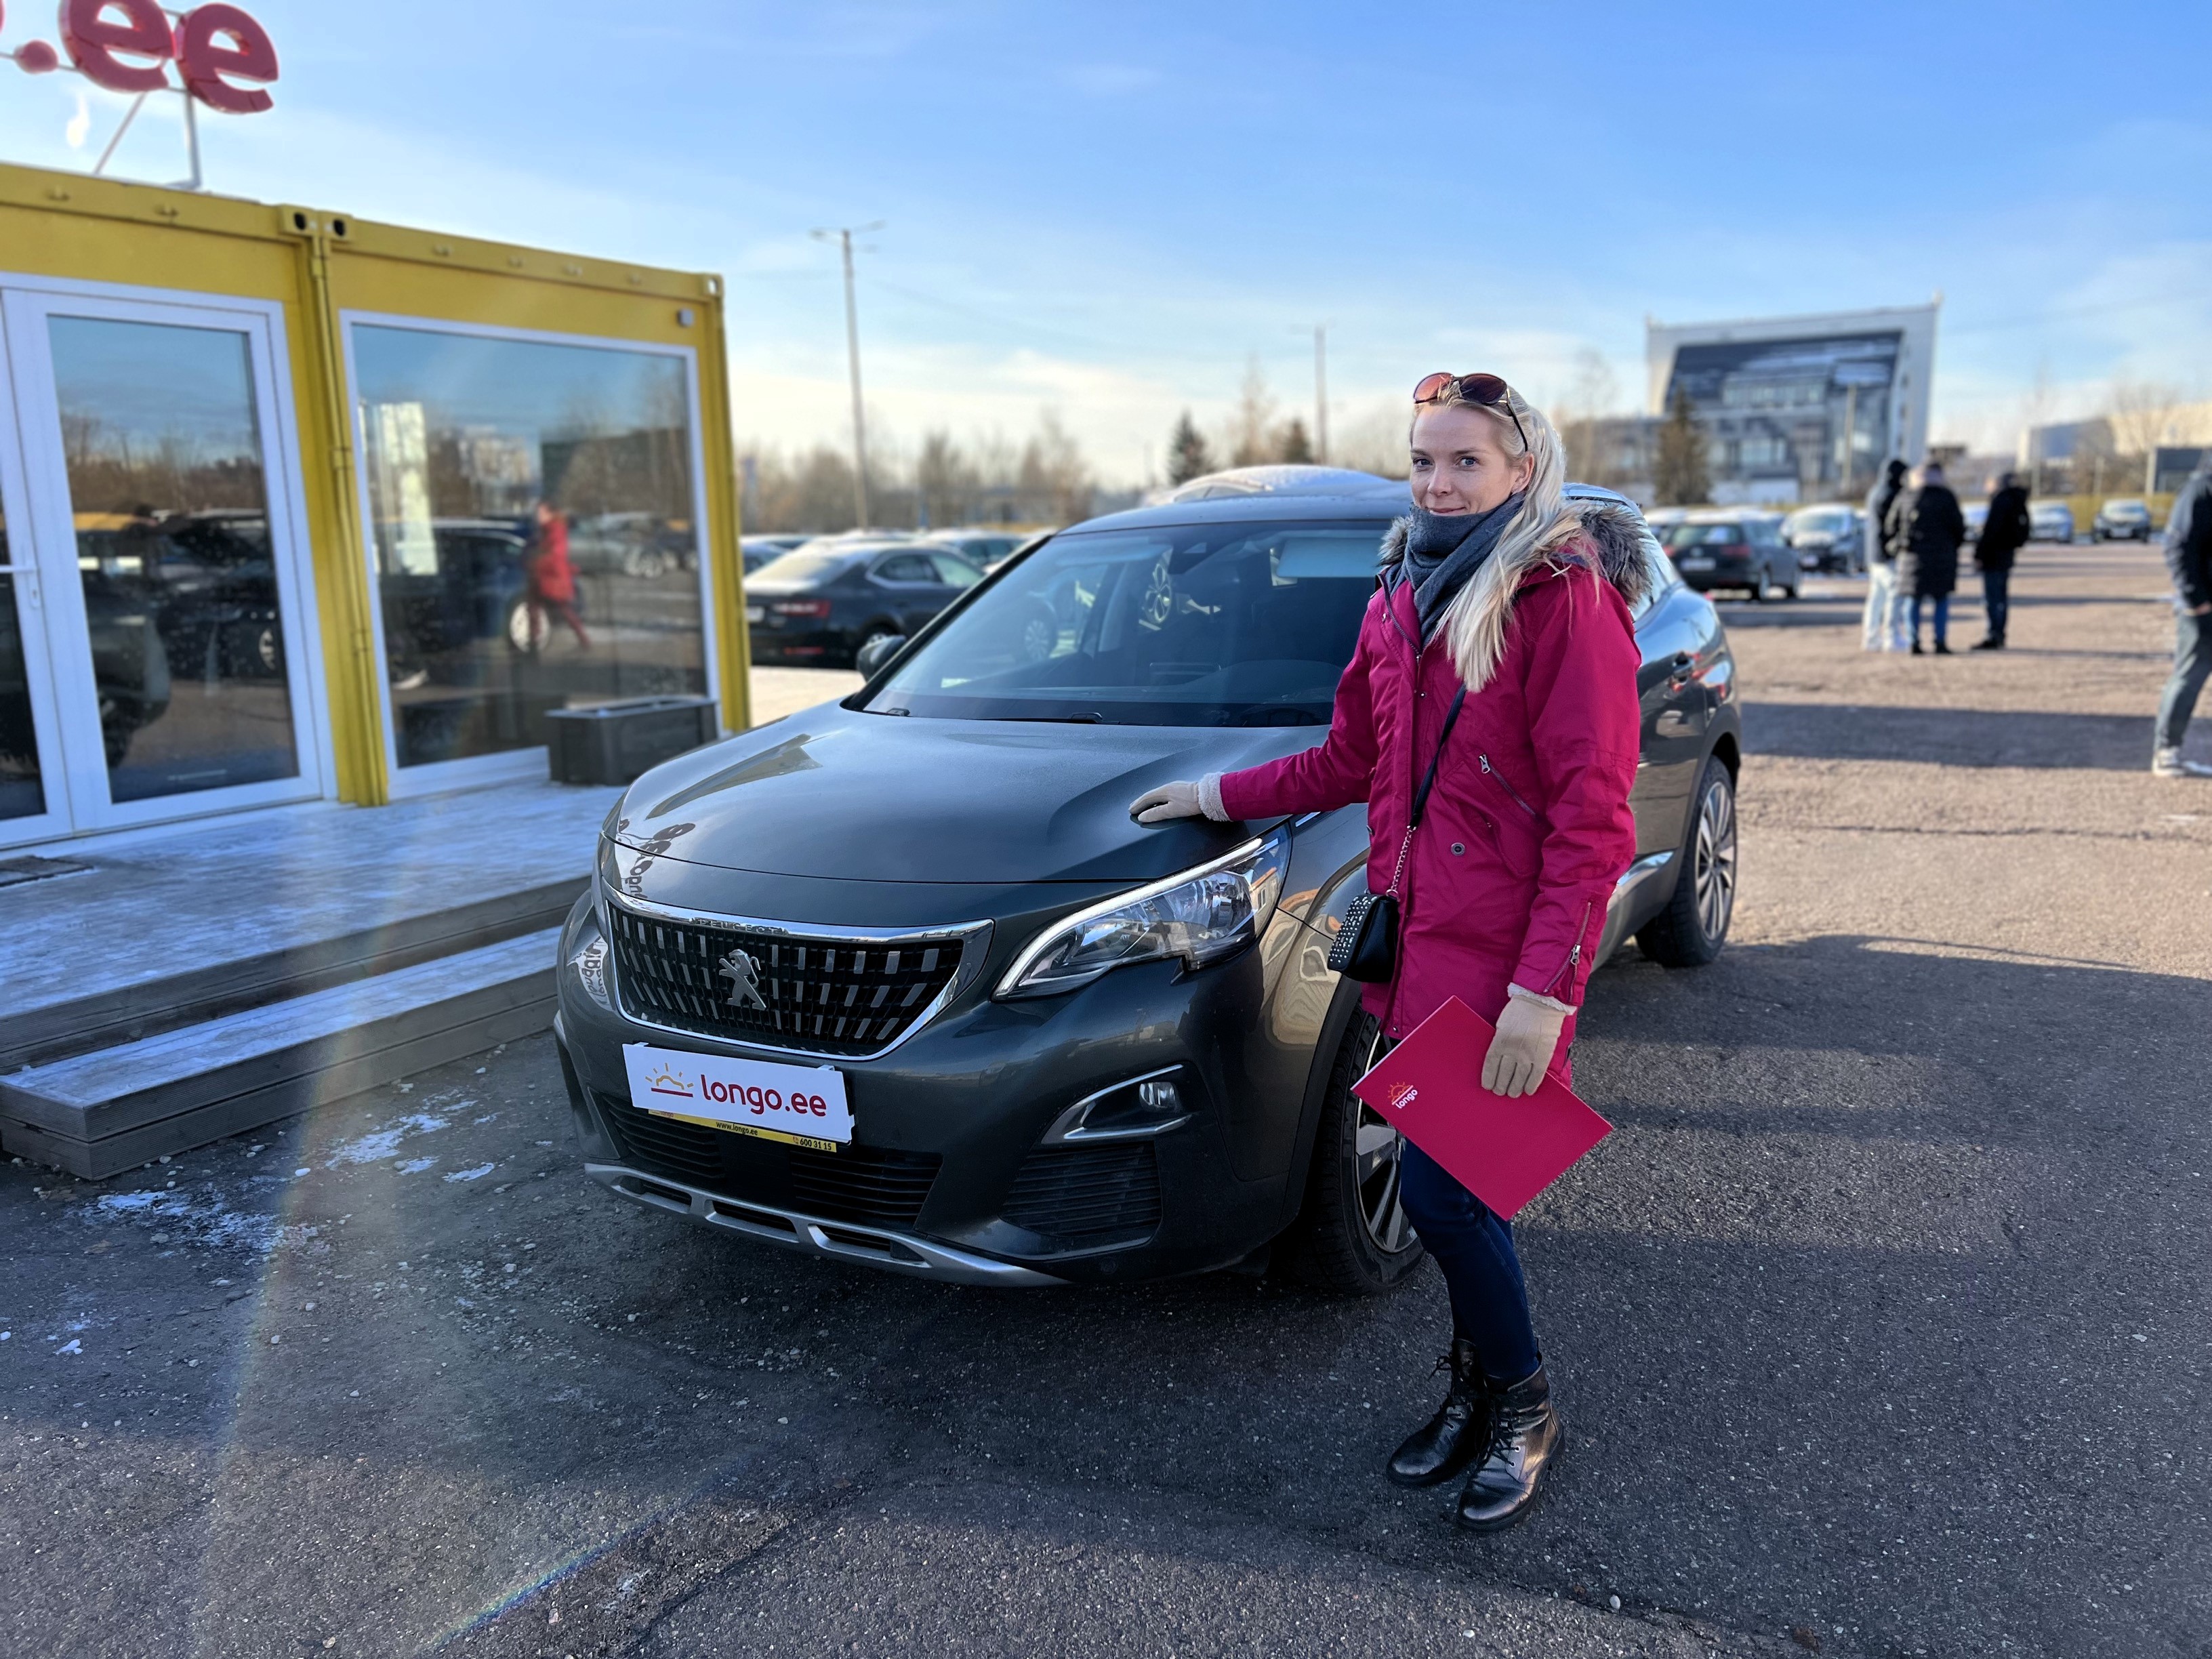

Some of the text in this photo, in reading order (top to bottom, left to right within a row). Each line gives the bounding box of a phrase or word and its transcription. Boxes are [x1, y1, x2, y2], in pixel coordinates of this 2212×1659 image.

[0, 0, 279, 115] .ee
[697, 918, 778, 935] PEUGEOT
[701, 1074, 827, 1117] longo.ee
[1395, 1089, 1418, 1109] longo
[716, 1121, 758, 1136] www.longo.ee
[800, 1138, 832, 1151] 600 31 15
